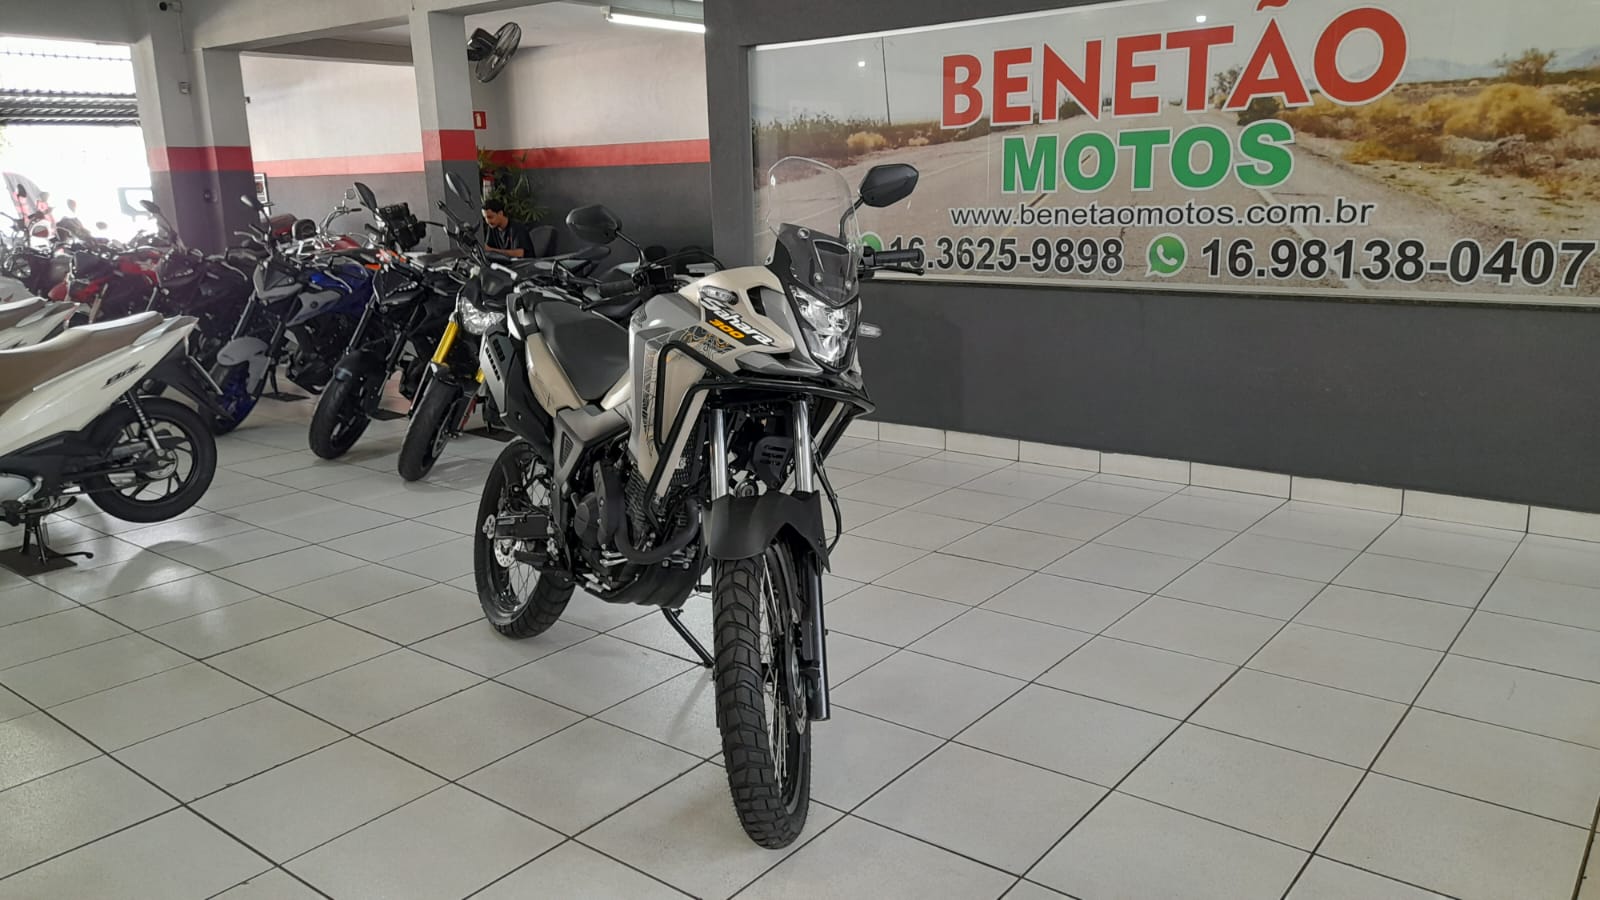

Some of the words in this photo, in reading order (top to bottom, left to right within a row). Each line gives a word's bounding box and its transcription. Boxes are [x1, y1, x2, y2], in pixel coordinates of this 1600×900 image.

[942, 0, 1407, 127] BENETÃO
[1002, 122, 1294, 192] MOTOS
[950, 198, 1375, 226] www.benetaomotos.com.br
[1202, 238, 1596, 287] 16.98138-0407
[699, 297, 775, 346] Sahara
[708, 318, 745, 339] 300
